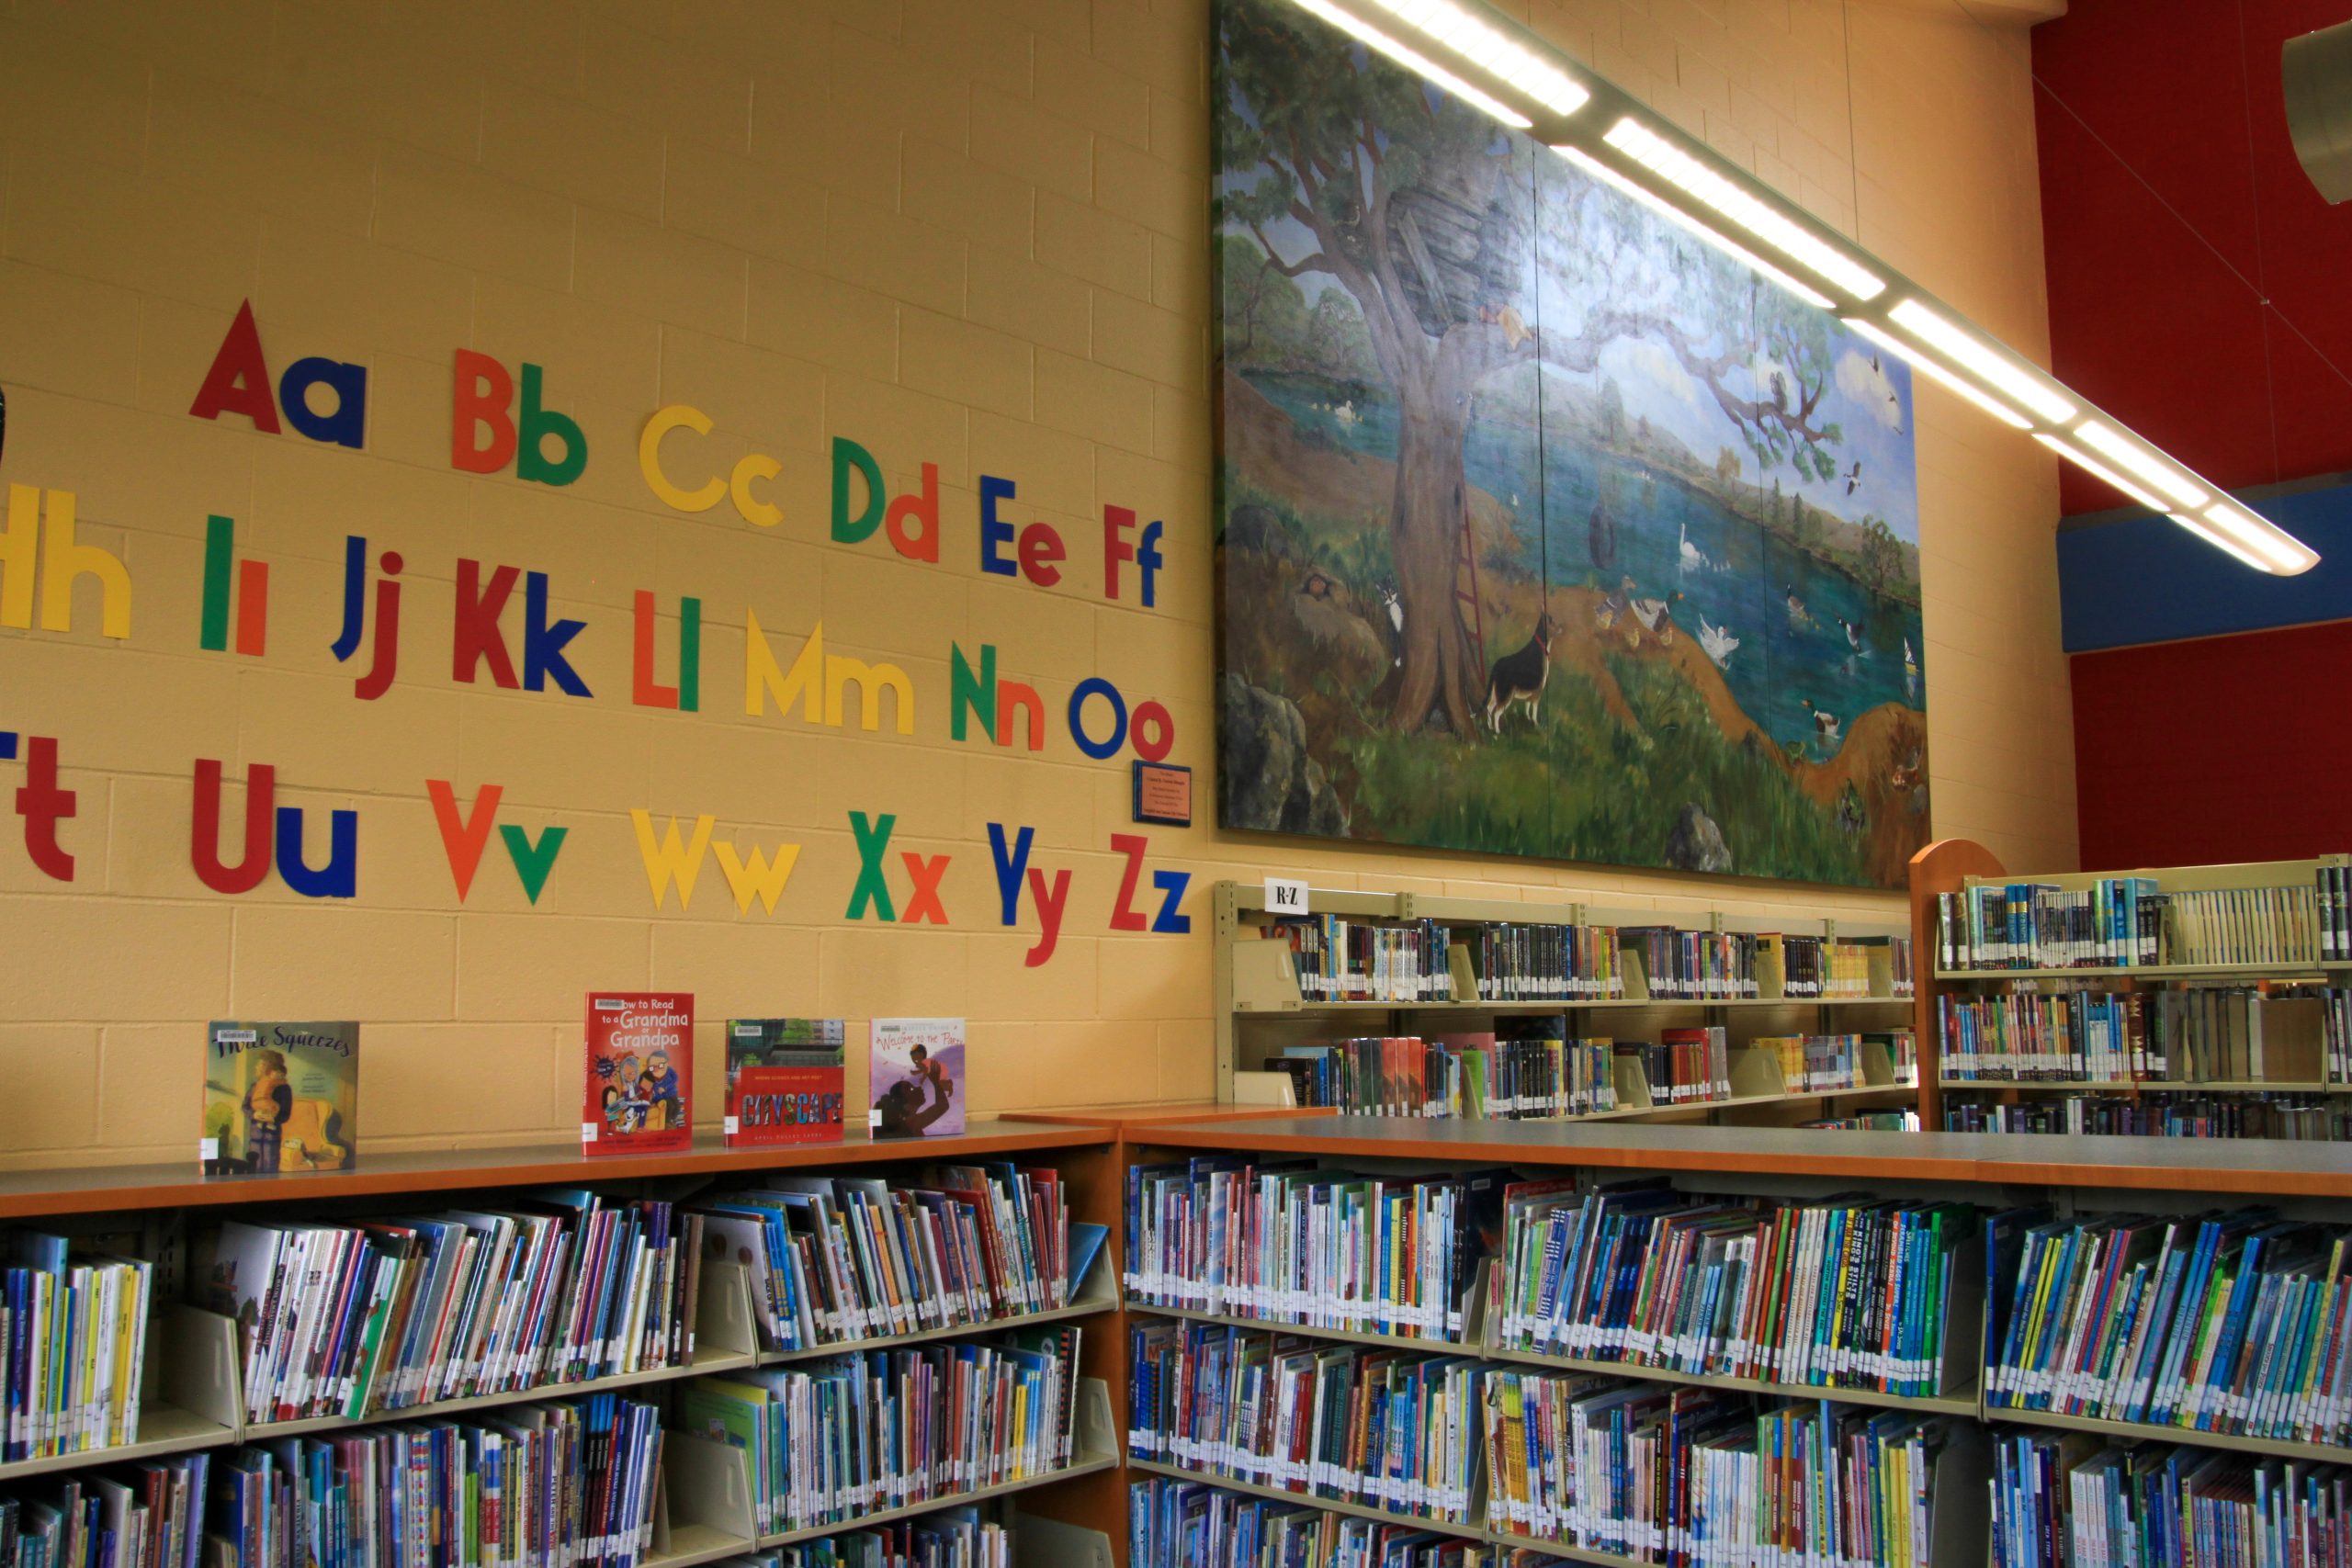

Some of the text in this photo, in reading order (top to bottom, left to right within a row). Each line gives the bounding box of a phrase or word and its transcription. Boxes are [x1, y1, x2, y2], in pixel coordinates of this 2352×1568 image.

[188, 297, 1163, 608] Aa Bb Cc Dd Ee Ff
[330, 535, 404, 701] Jj
[452, 557, 594, 698] Kk
[632, 589, 700, 713] Ll
[745, 604, 914, 736] Mm
[950, 638, 1045, 750] Nn
[1068, 677, 1174, 763] Oo
[0, 731, 1192, 968] t Uu Vv Ww Xx Yy Zz
[1275, 886, 1298, 906] R-Z
[602, 1015, 611, 1024] to
[620, 1010, 689, 1029] Grandma
[639, 999, 649, 1009] to
[651, 998, 674, 1010] Read
[273, 1025, 351, 1058] Squeezes
[610, 1028, 680, 1050] Grandpa
[741, 1092, 842, 1127] CITYSCAPE
[1854, 1231, 1862, 1263] KING'S
[1896, 1224, 1906, 1264] SCRAMBLED
[1849, 1267, 1860, 1300] STILTS
